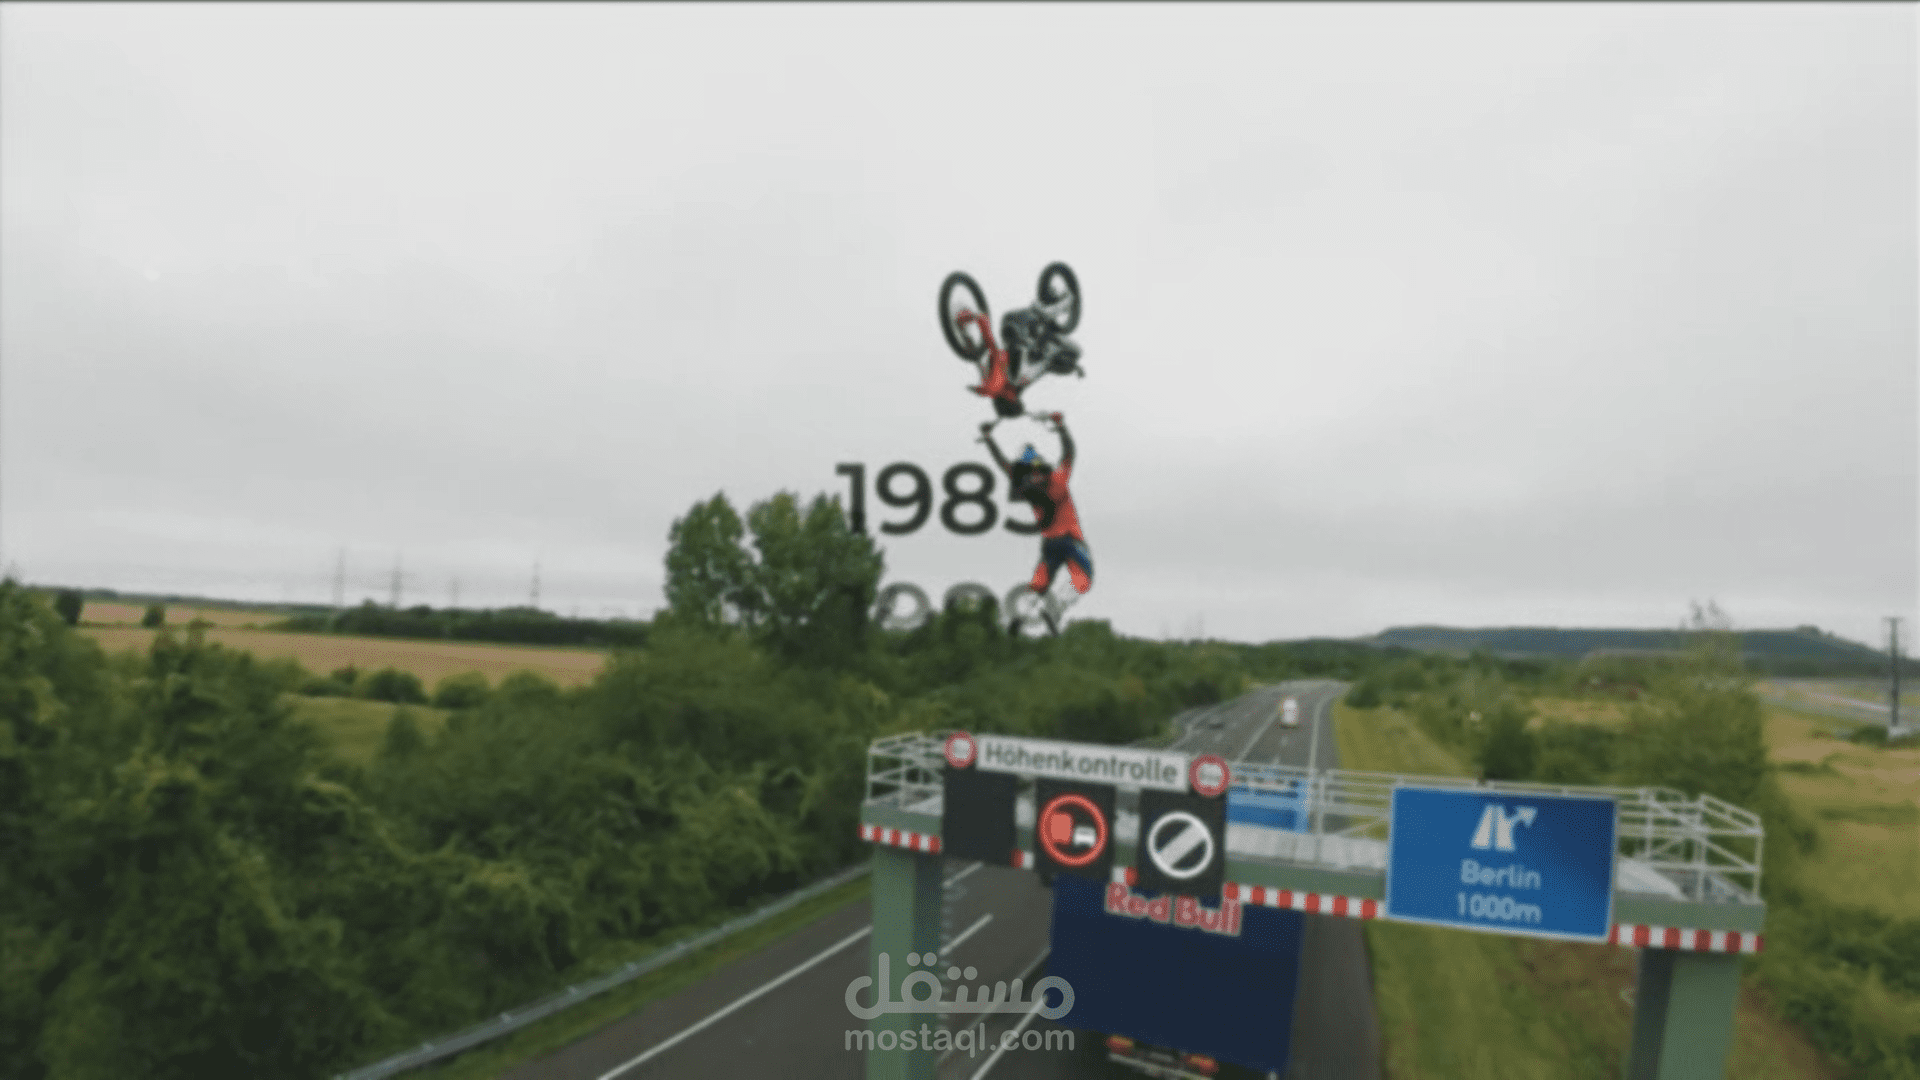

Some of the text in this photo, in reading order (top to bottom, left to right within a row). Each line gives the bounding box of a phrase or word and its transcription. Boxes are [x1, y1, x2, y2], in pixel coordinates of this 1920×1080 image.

[984, 743, 1178, 783] Höhenkontrolle
[1461, 859, 1541, 889] Berlin
[1105, 881, 1242, 937] Red Bull
[1458, 892, 1541, 922] 1000m
